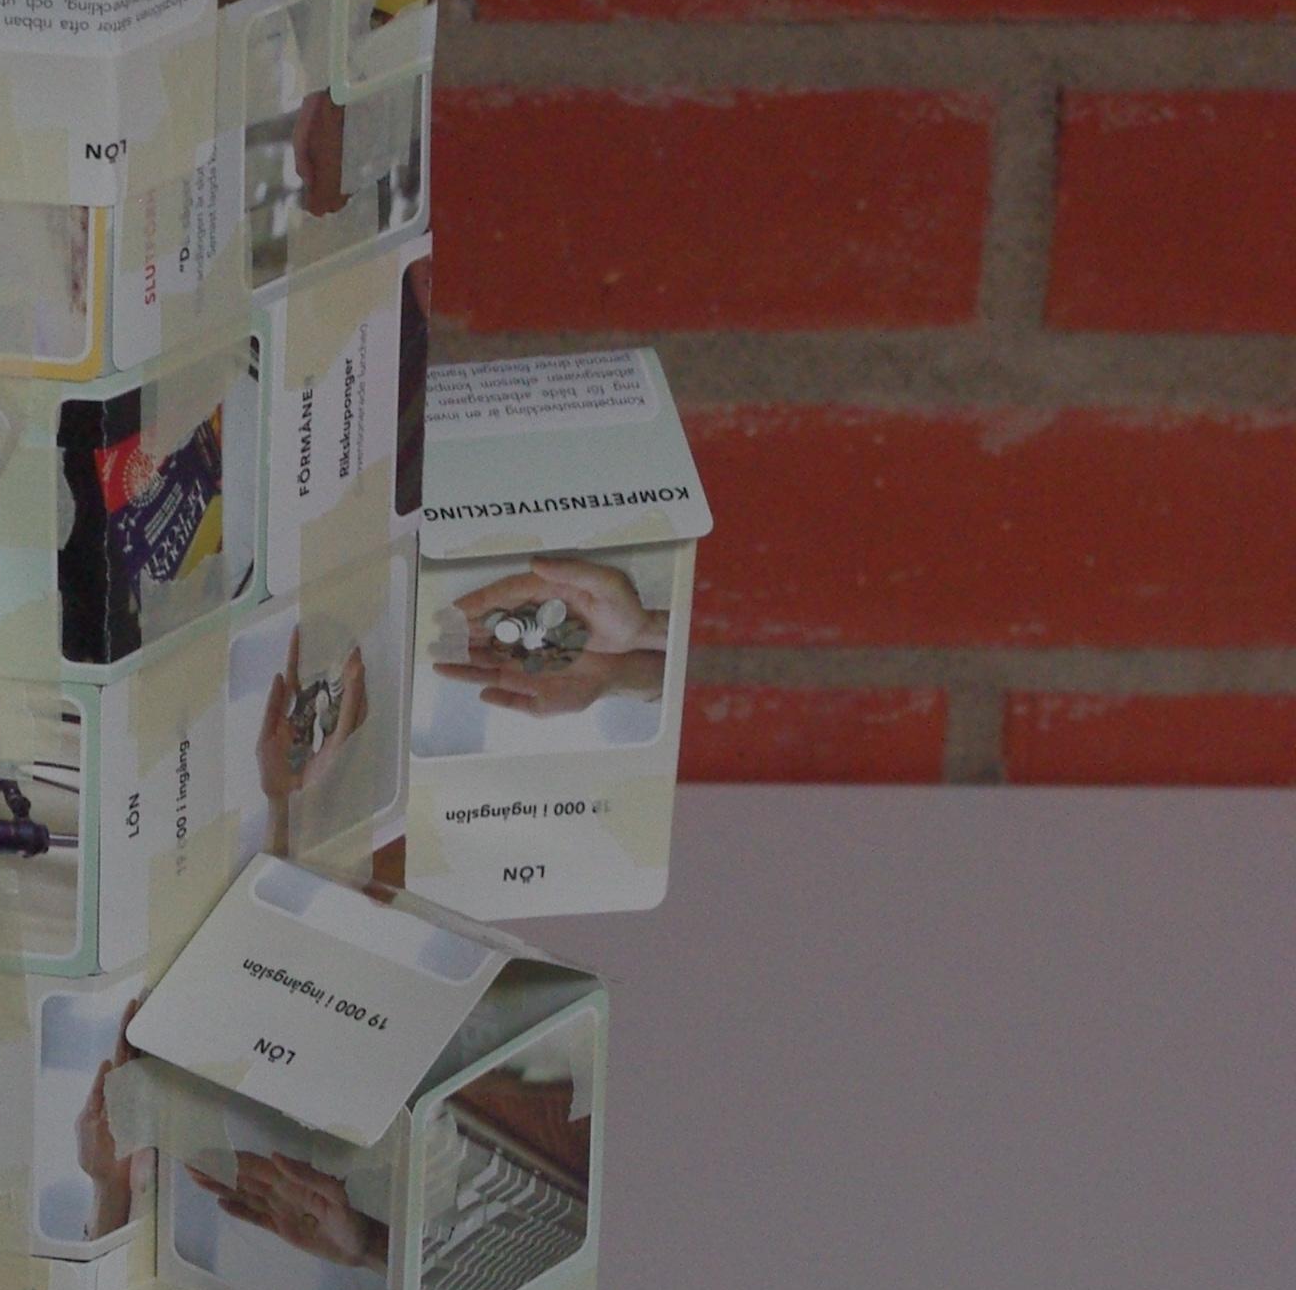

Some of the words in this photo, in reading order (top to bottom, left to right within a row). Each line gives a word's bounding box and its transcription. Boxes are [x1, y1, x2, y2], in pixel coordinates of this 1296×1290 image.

[85, 138, 128, 163] LÖN
[338, 356, 356, 479] Rikskuponger
[423, 487, 690, 522] KOMPETENSUTVECKLING
[126, 792, 141, 839] LÖN
[445, 801, 537, 825] ingångslön
[554, 801, 586, 817] 000
[503, 864, 546, 885] LÖN
[242, 957, 323, 1008] ingångslön
[335, 998, 366, 1022] 000
[368, 1014, 389, 1032] 19
[253, 1036, 296, 1067] LÖN
